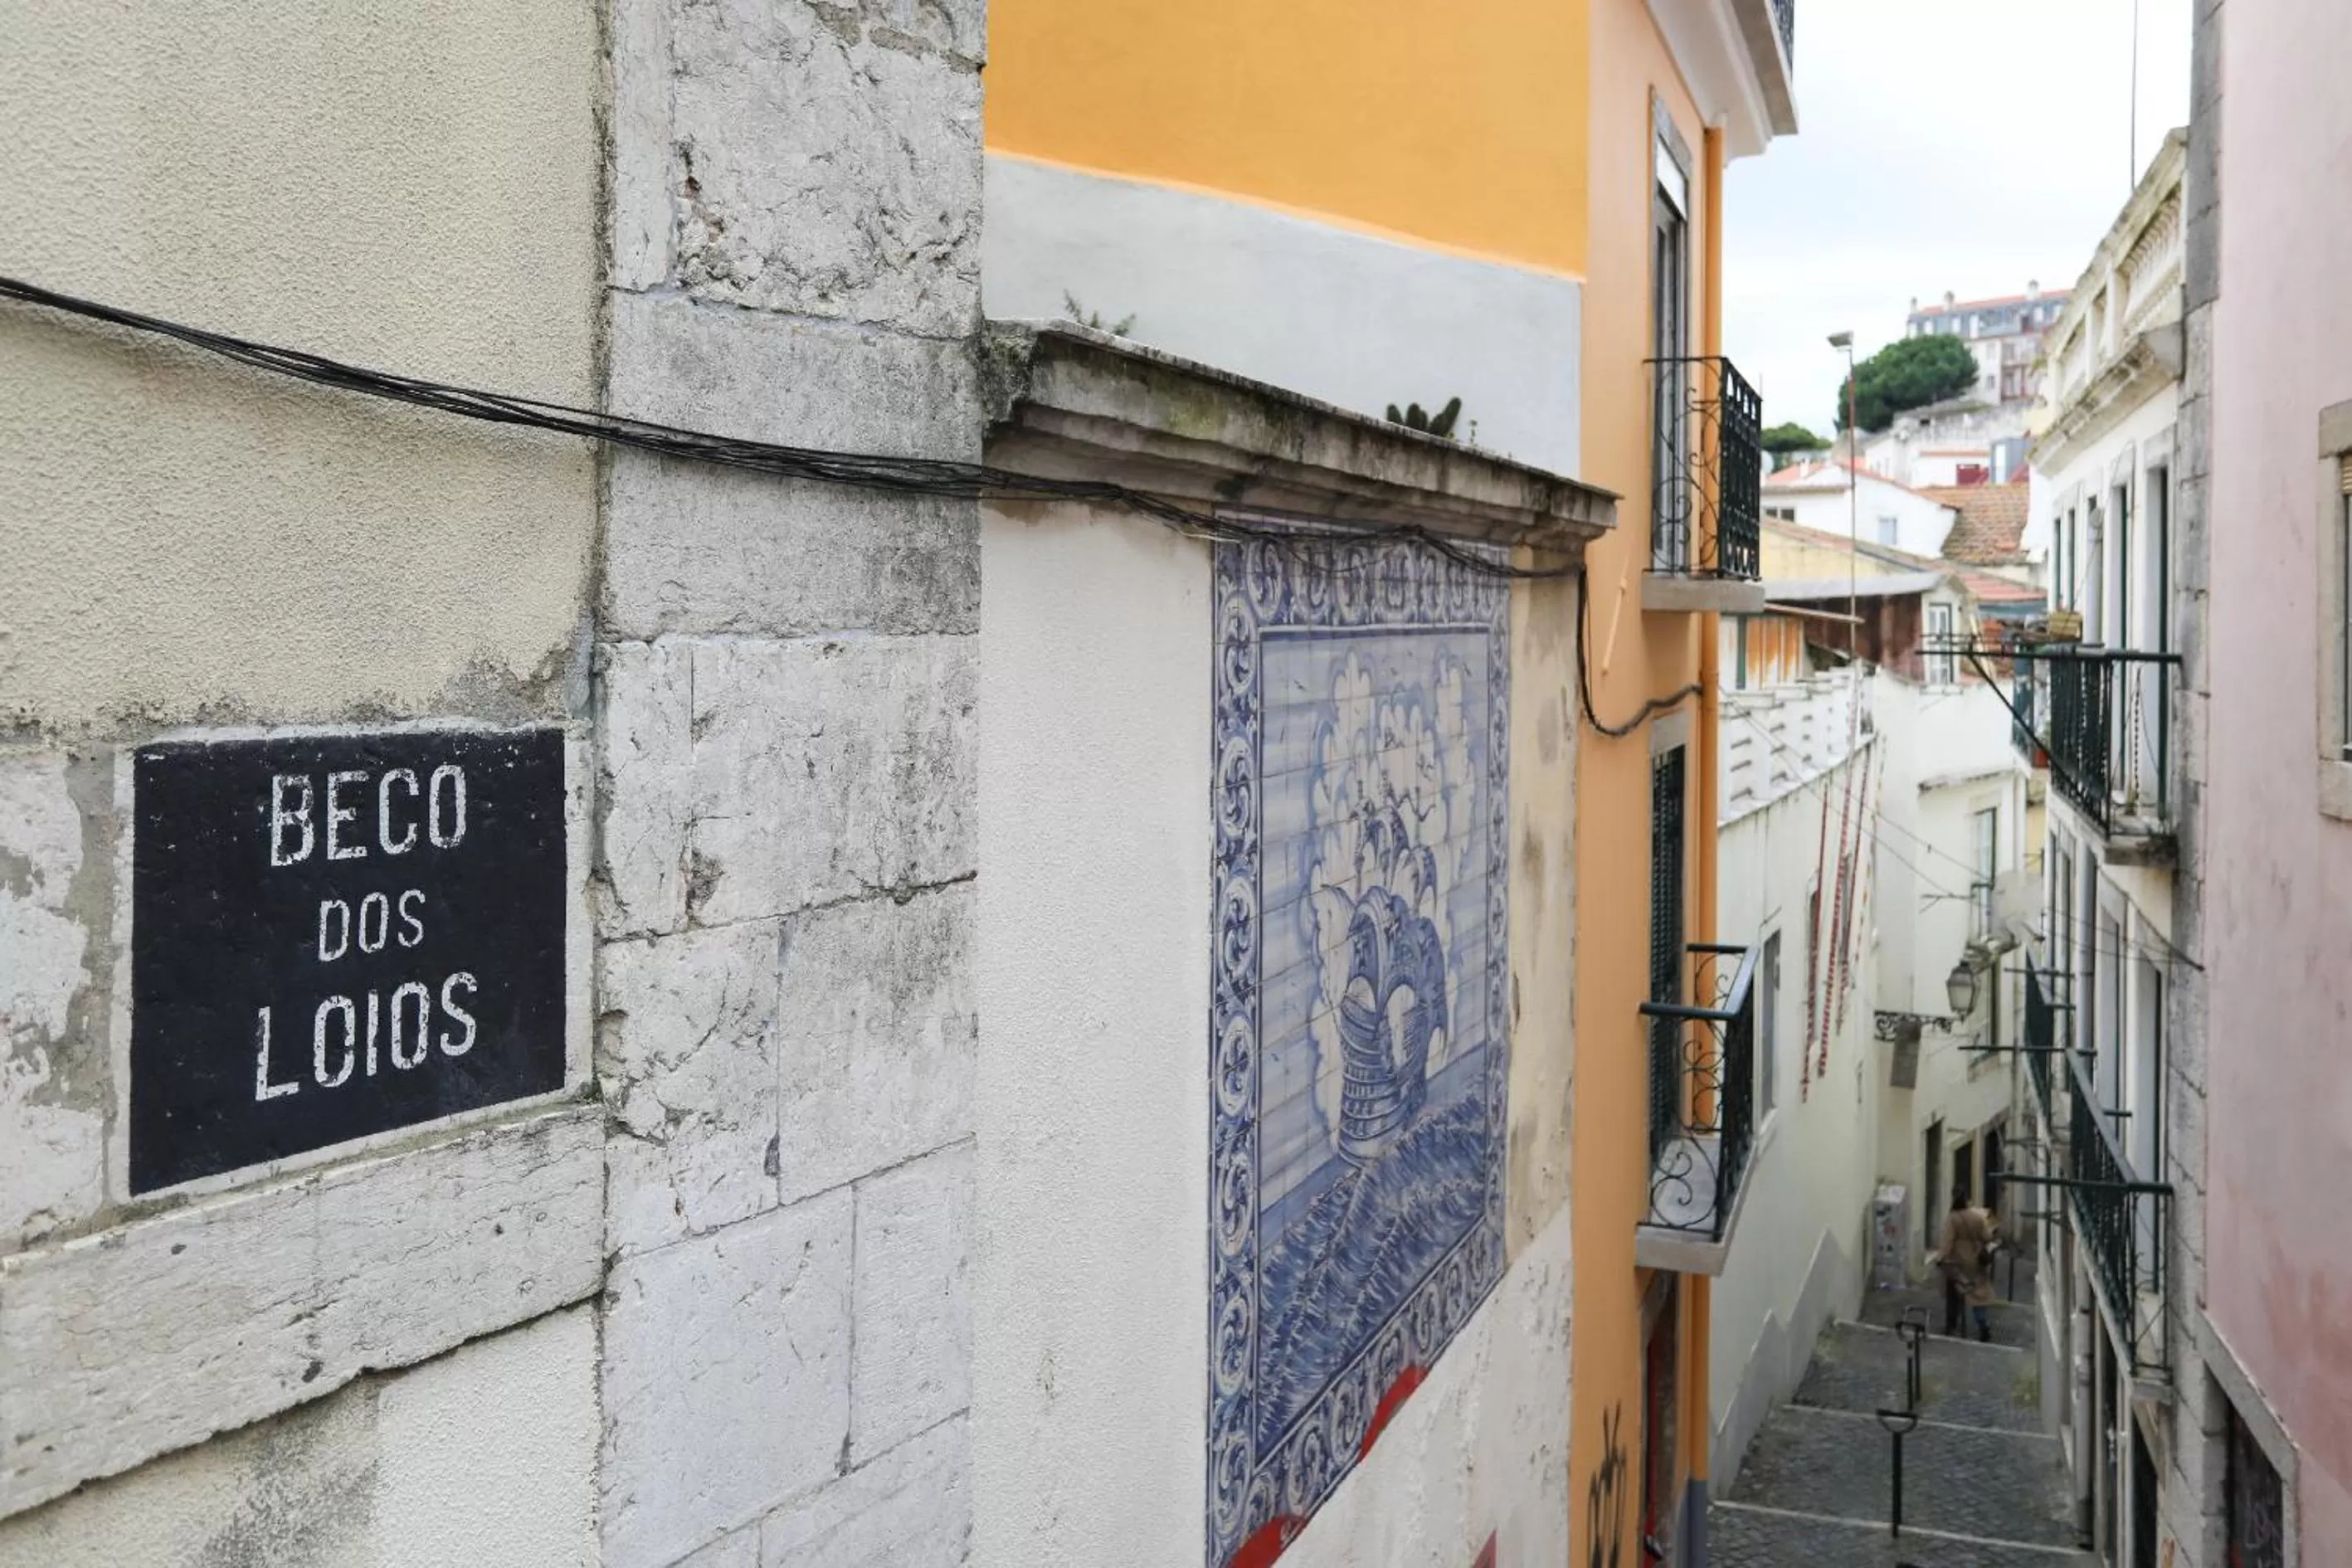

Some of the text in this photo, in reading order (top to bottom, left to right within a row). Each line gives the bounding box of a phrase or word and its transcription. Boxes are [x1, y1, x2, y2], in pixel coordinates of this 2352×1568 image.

[270, 764, 466, 866] BECO
[318, 889, 426, 962] DOS
[255, 971, 478, 1101] LOIOS
